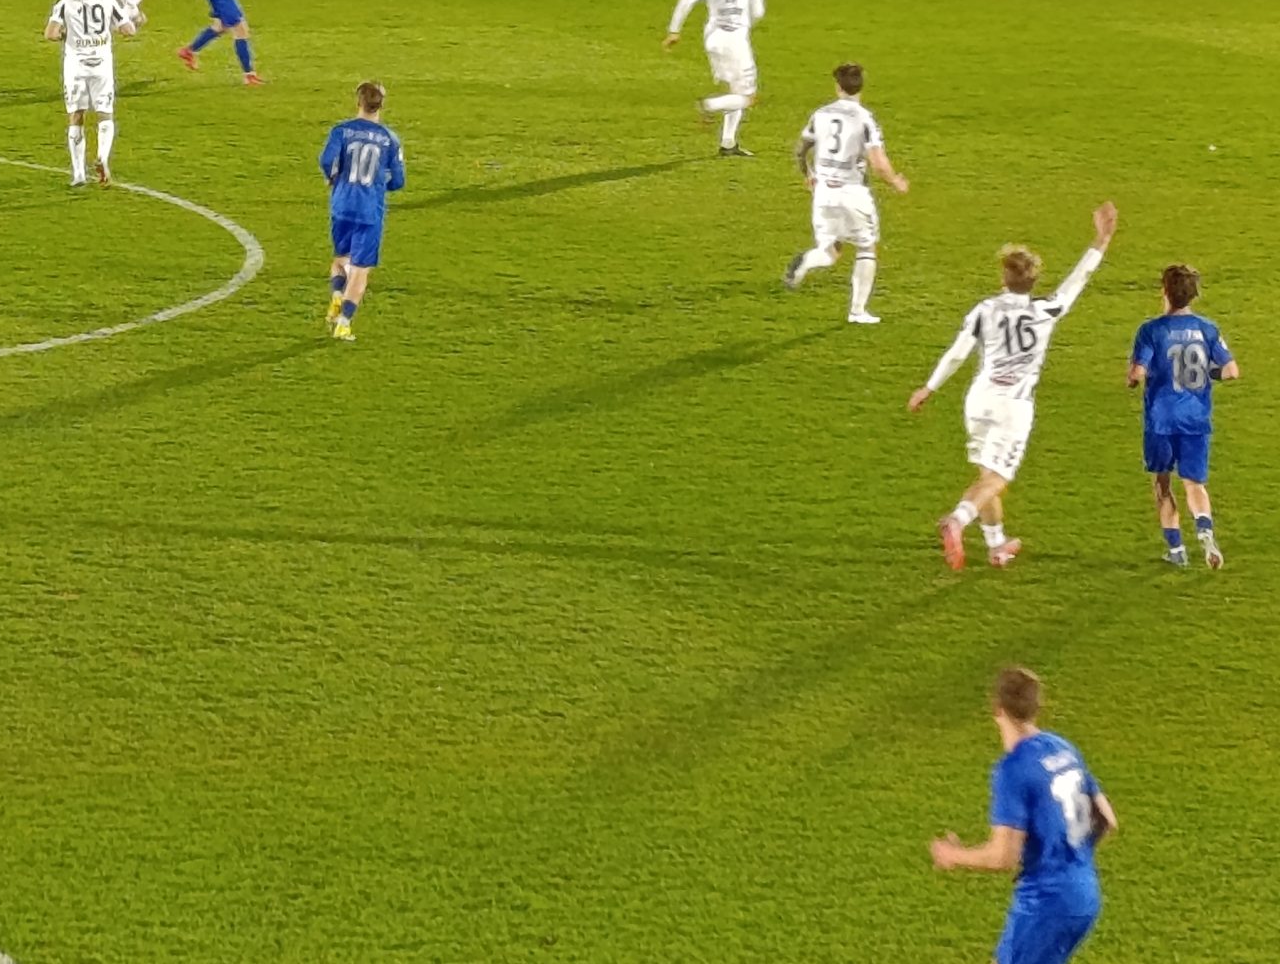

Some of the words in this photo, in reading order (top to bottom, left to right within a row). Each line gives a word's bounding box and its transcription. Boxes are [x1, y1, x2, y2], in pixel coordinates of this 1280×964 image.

[82, 4, 105, 35] 19
[828, 118, 842, 154] 3
[347, 141, 380, 187] 10
[998, 314, 1038, 355] 16
[1167, 343, 1209, 393] 18
